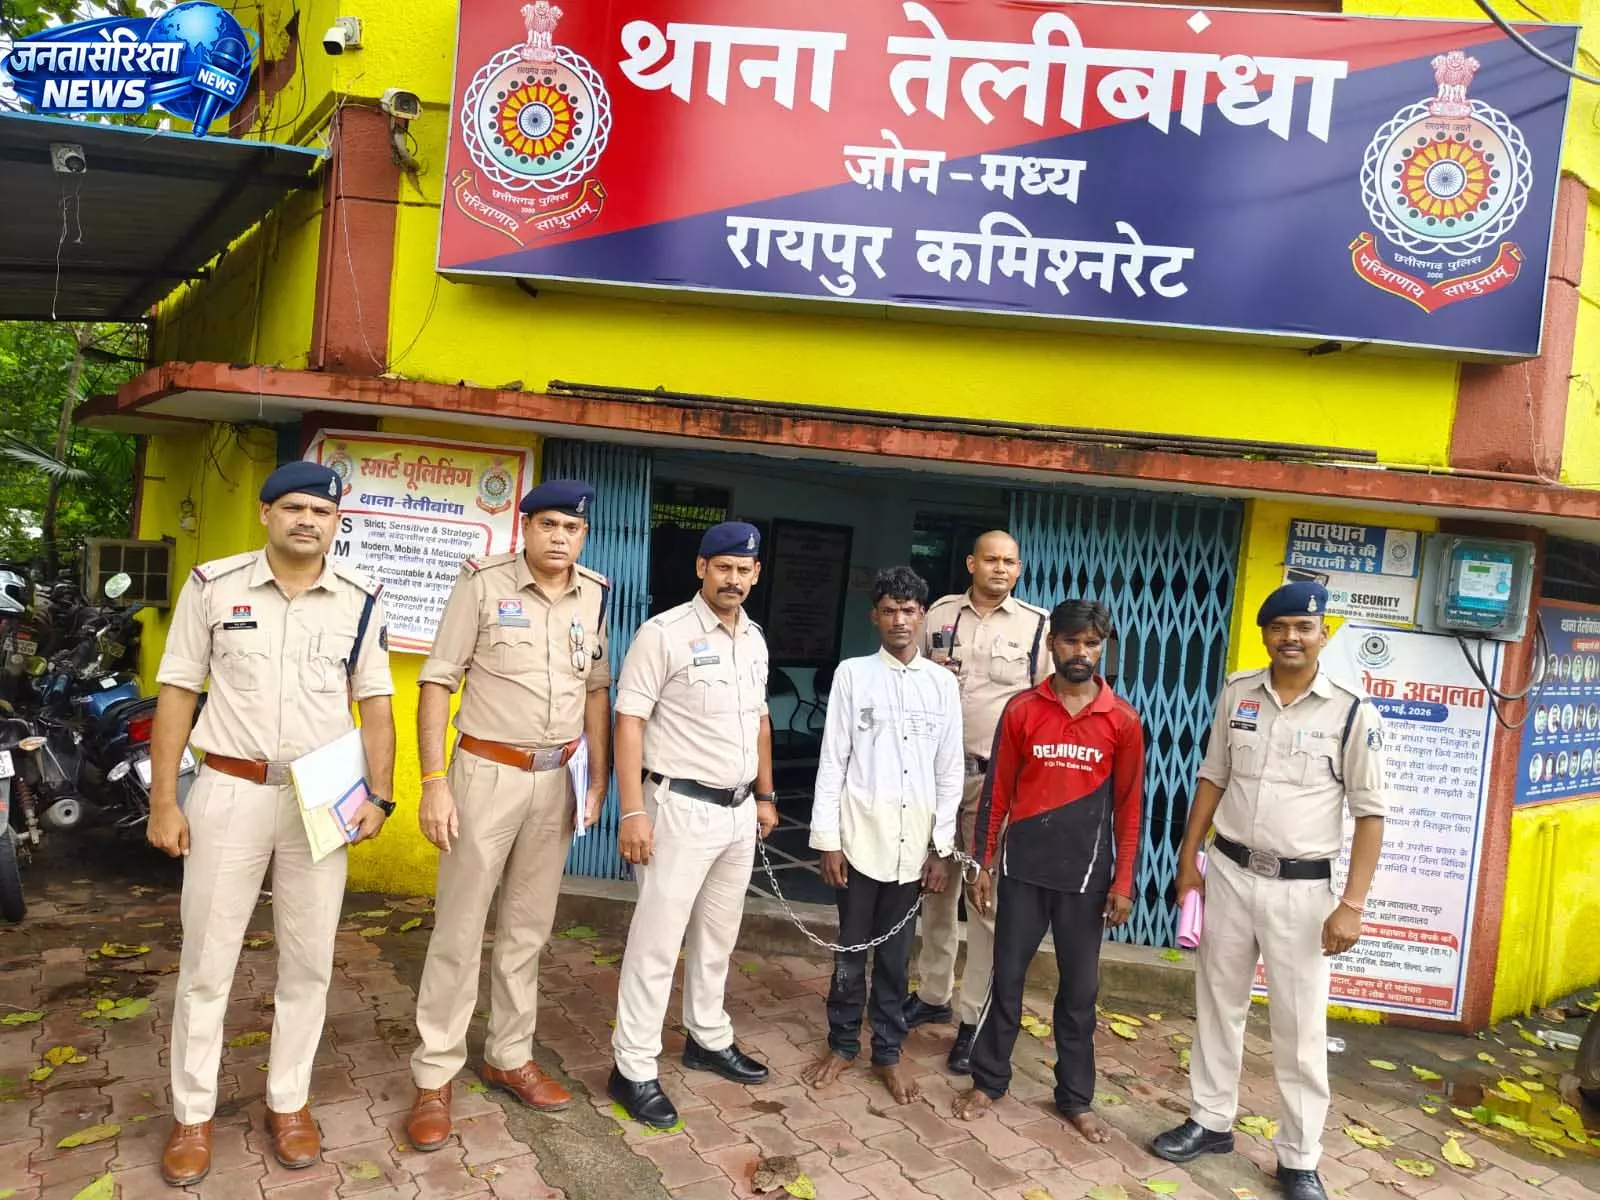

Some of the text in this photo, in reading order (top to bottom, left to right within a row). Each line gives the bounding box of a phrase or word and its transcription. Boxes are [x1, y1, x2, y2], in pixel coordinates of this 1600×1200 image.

[618, 1, 1348, 144] थाना तेलीबांधा
[726, 211, 1195, 298] रायपुर कमिश्नरेट
[1448, 255, 1482, 271] पुलिस
[341, 517, 353, 534] S
[389, 521, 430, 533] Sensitive
[431, 526, 438, 534] &
[441, 527, 480, 540] Strategic
[1295, 521, 1368, 542] सावधान
[333, 540, 350, 557] M
[394, 544, 421, 554] Mobile
[1291, 551, 1346, 570] निगरानी
[377, 565, 425, 578] Accountable
[427, 571, 433, 579] &
[384, 591, 428, 605] Responsive
[429, 597, 436, 605] &
[1351, 593, 1401, 608] SECURITY
[1361, 670, 1488, 709] ोक अदालत
[1379, 704, 1390, 713] 09
[1408, 707, 1432, 717] 2026
